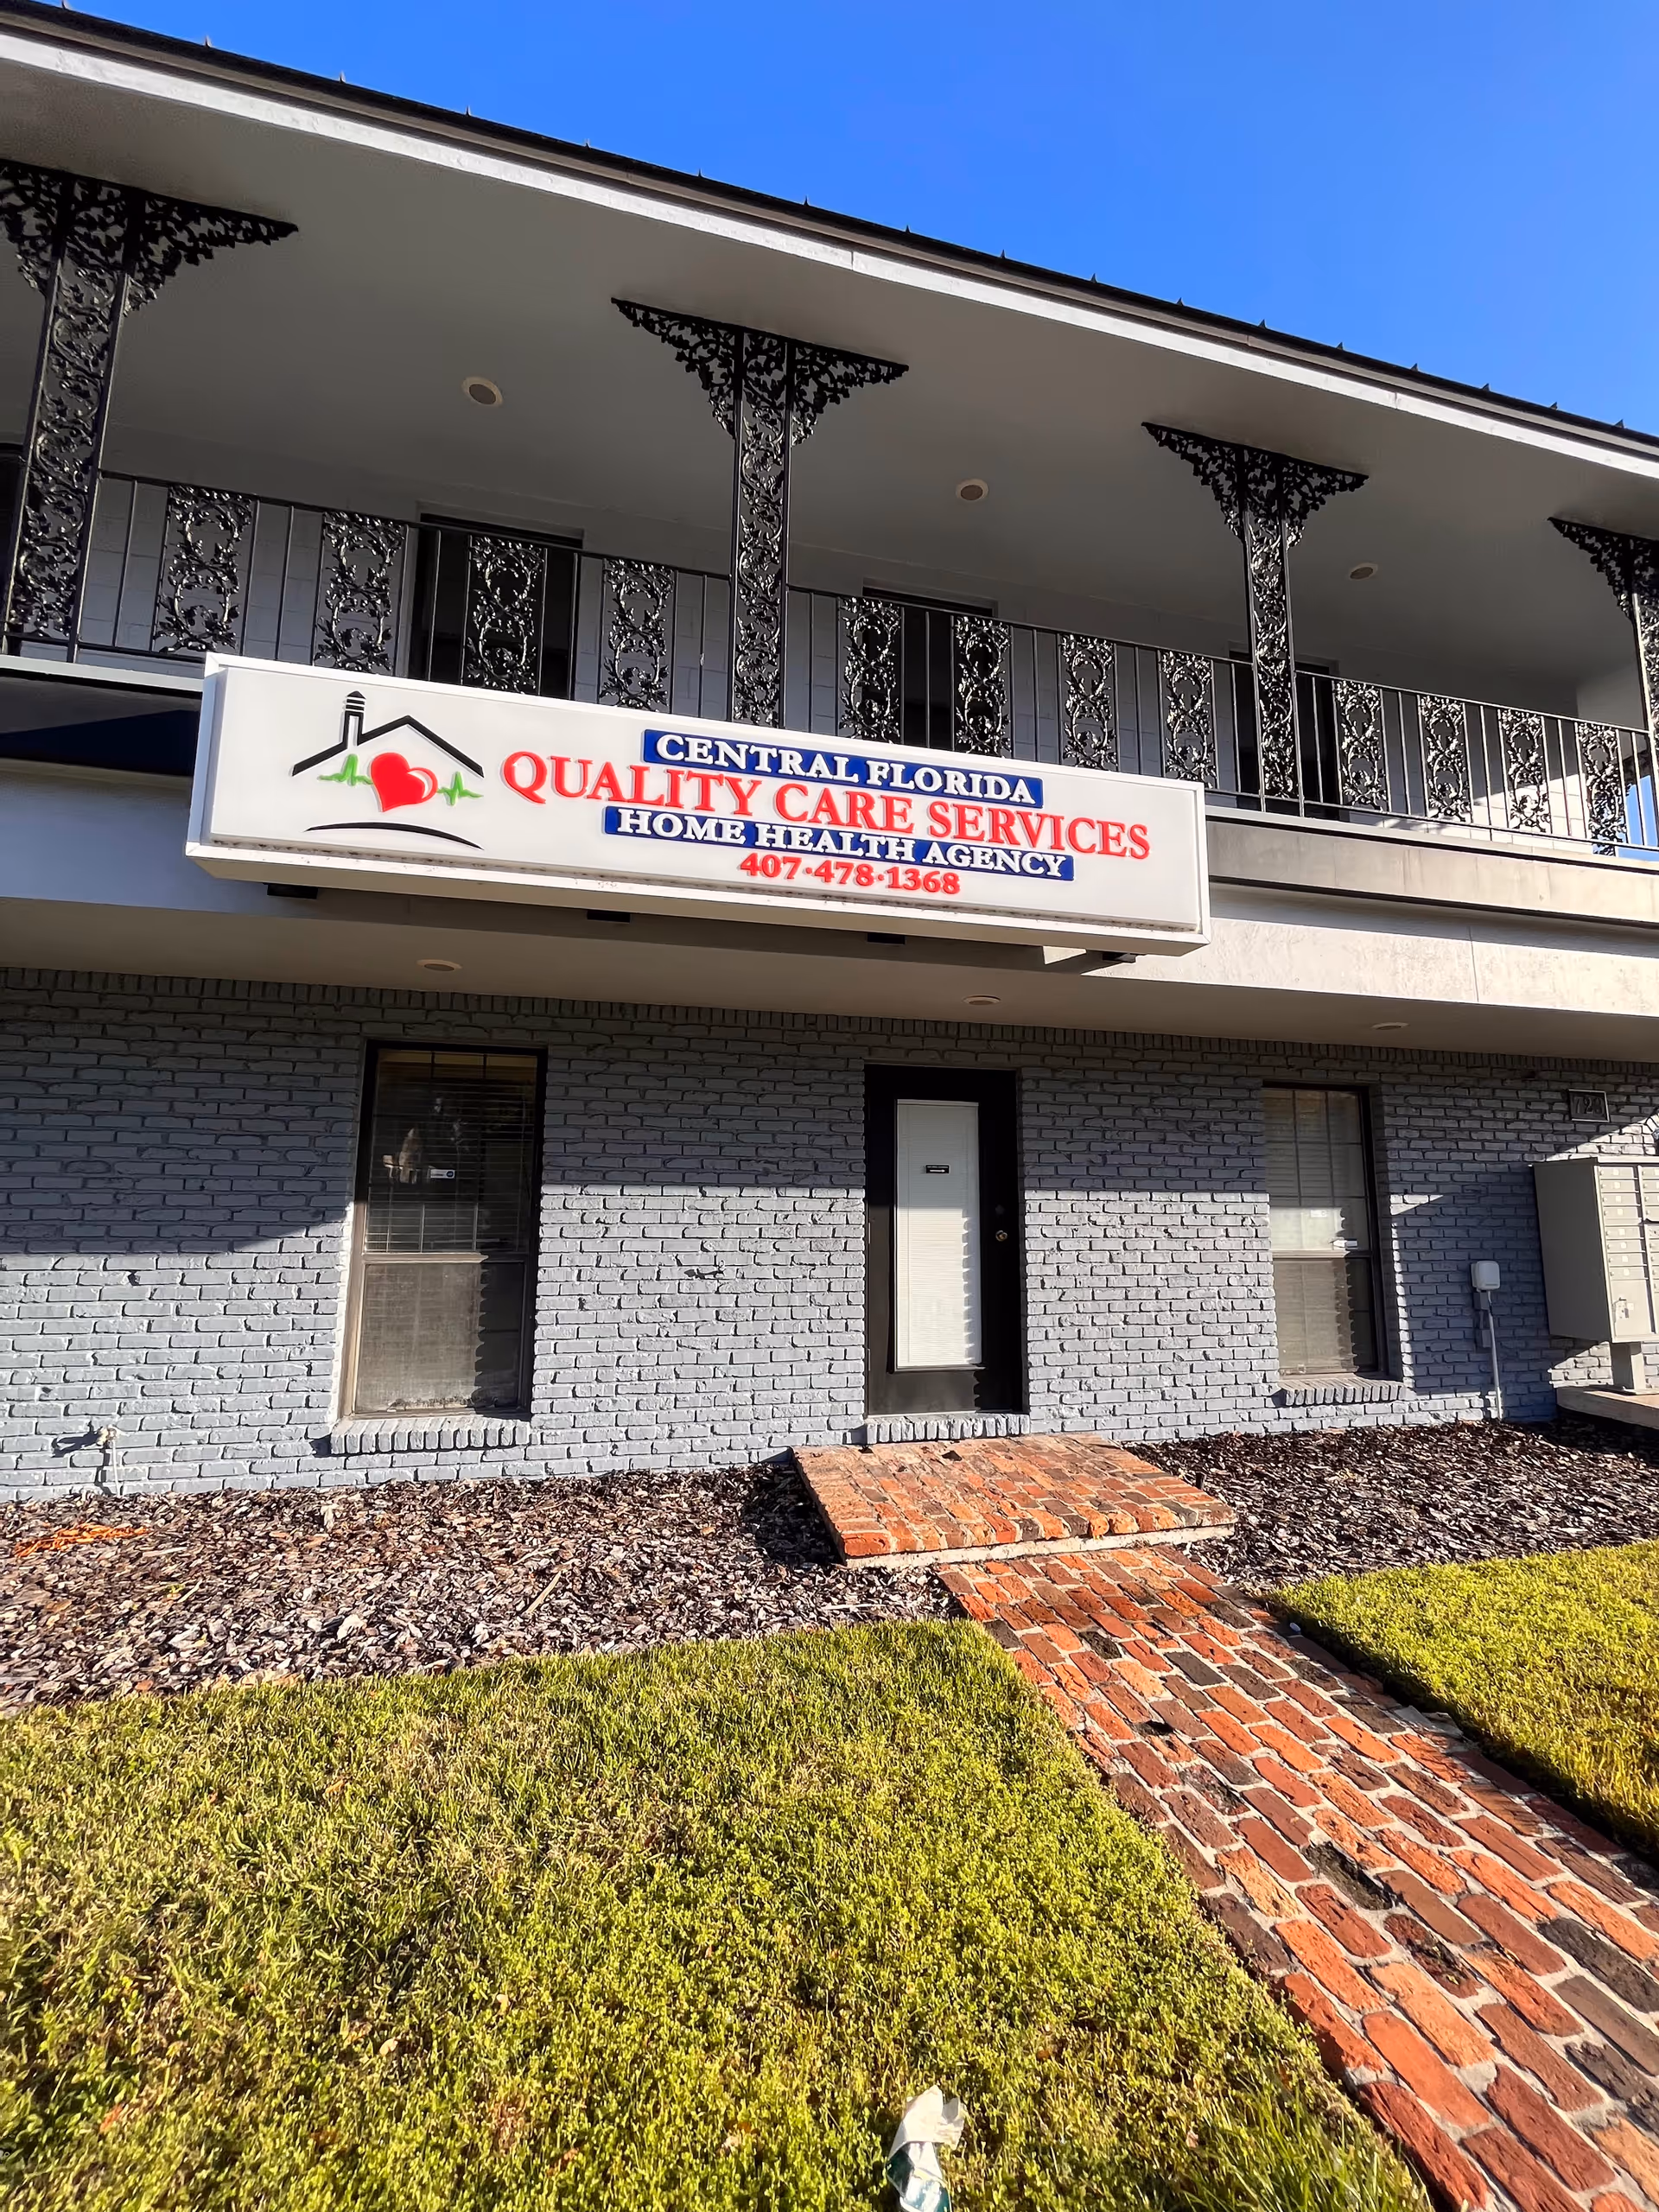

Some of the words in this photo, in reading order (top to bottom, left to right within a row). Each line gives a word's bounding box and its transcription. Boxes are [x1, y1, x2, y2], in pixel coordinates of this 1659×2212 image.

[657, 734, 859, 783] CENTRAL
[866, 760, 1035, 804] FLORIDA
[504, 752, 762, 816] QUALITY
[775, 784, 914, 834] CARE
[929, 802, 1150, 859] SERVICES
[617, 809, 746, 844] HOME
[755, 823, 916, 862] HEALTH
[922, 842, 1066, 877] AGENCY
